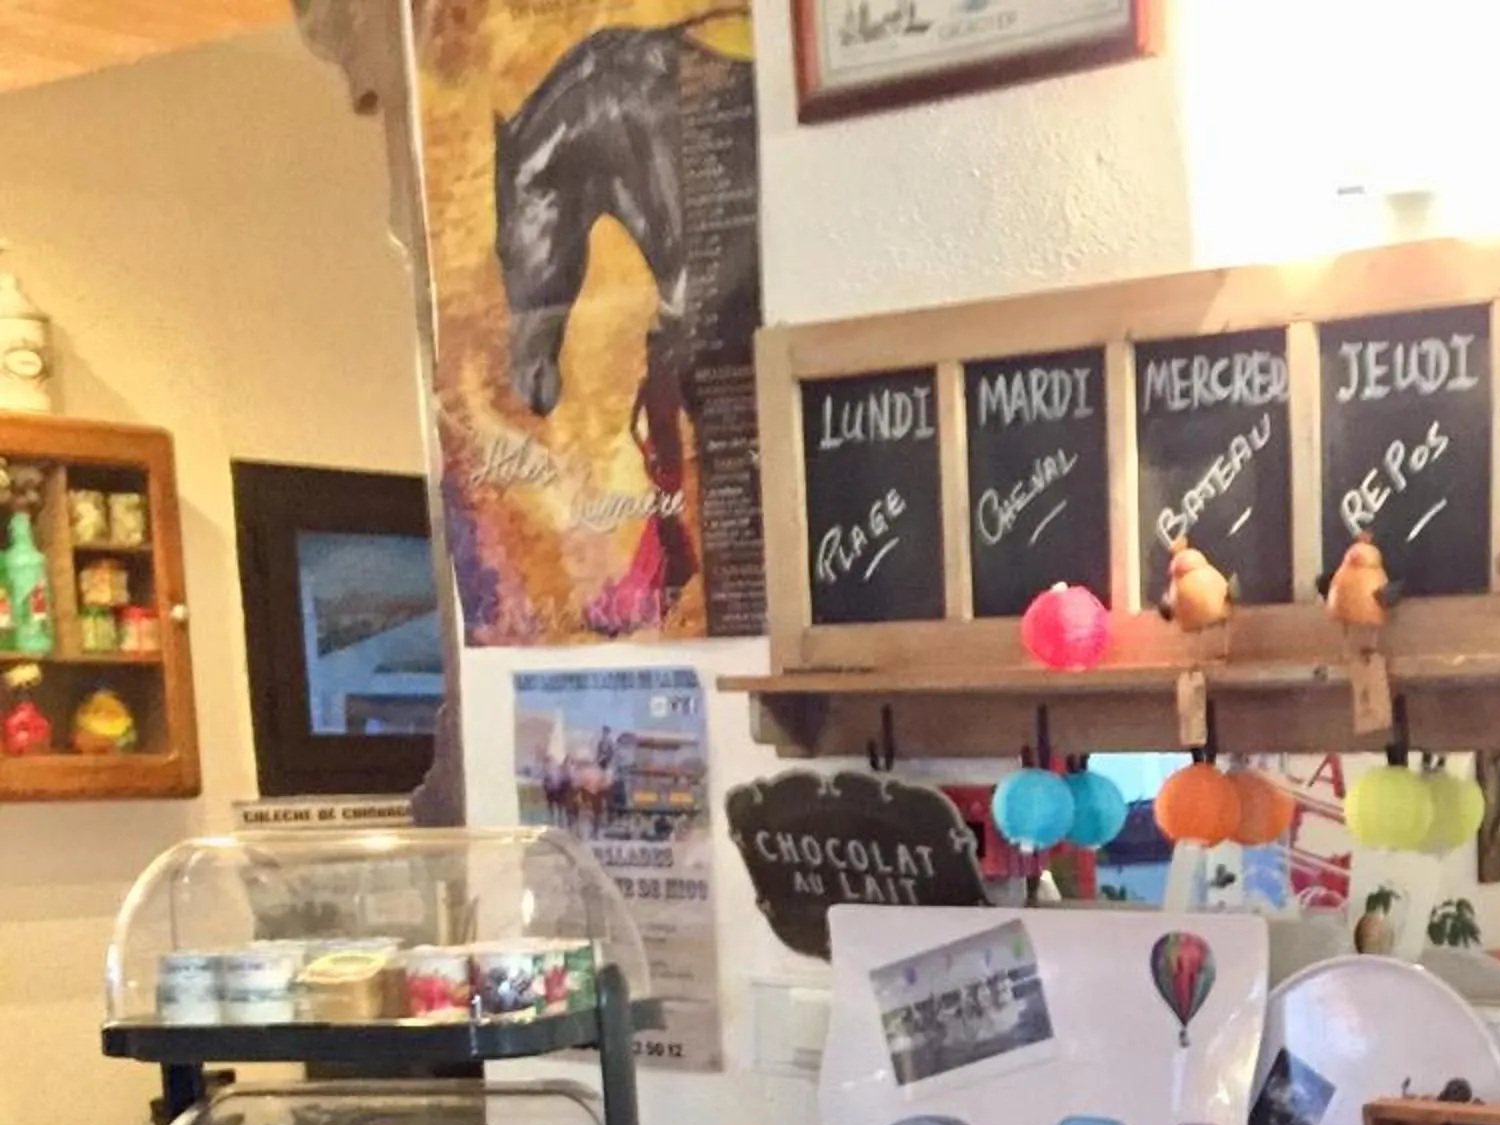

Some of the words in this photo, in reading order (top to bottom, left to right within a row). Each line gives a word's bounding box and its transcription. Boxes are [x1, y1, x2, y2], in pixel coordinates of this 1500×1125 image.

[977, 366, 1094, 426] MARDI
[1336, 334, 1477, 400] JEUDI
[820, 388, 935, 449] LUNDI
[1157, 413, 1270, 549] BATEAU
[1341, 422, 1449, 534] REPOS
[816, 488, 906, 584] PLAGE
[755, 831, 934, 877] CHOCOLAT
[793, 871, 825, 896] AU
[842, 871, 920, 905] LAIT
